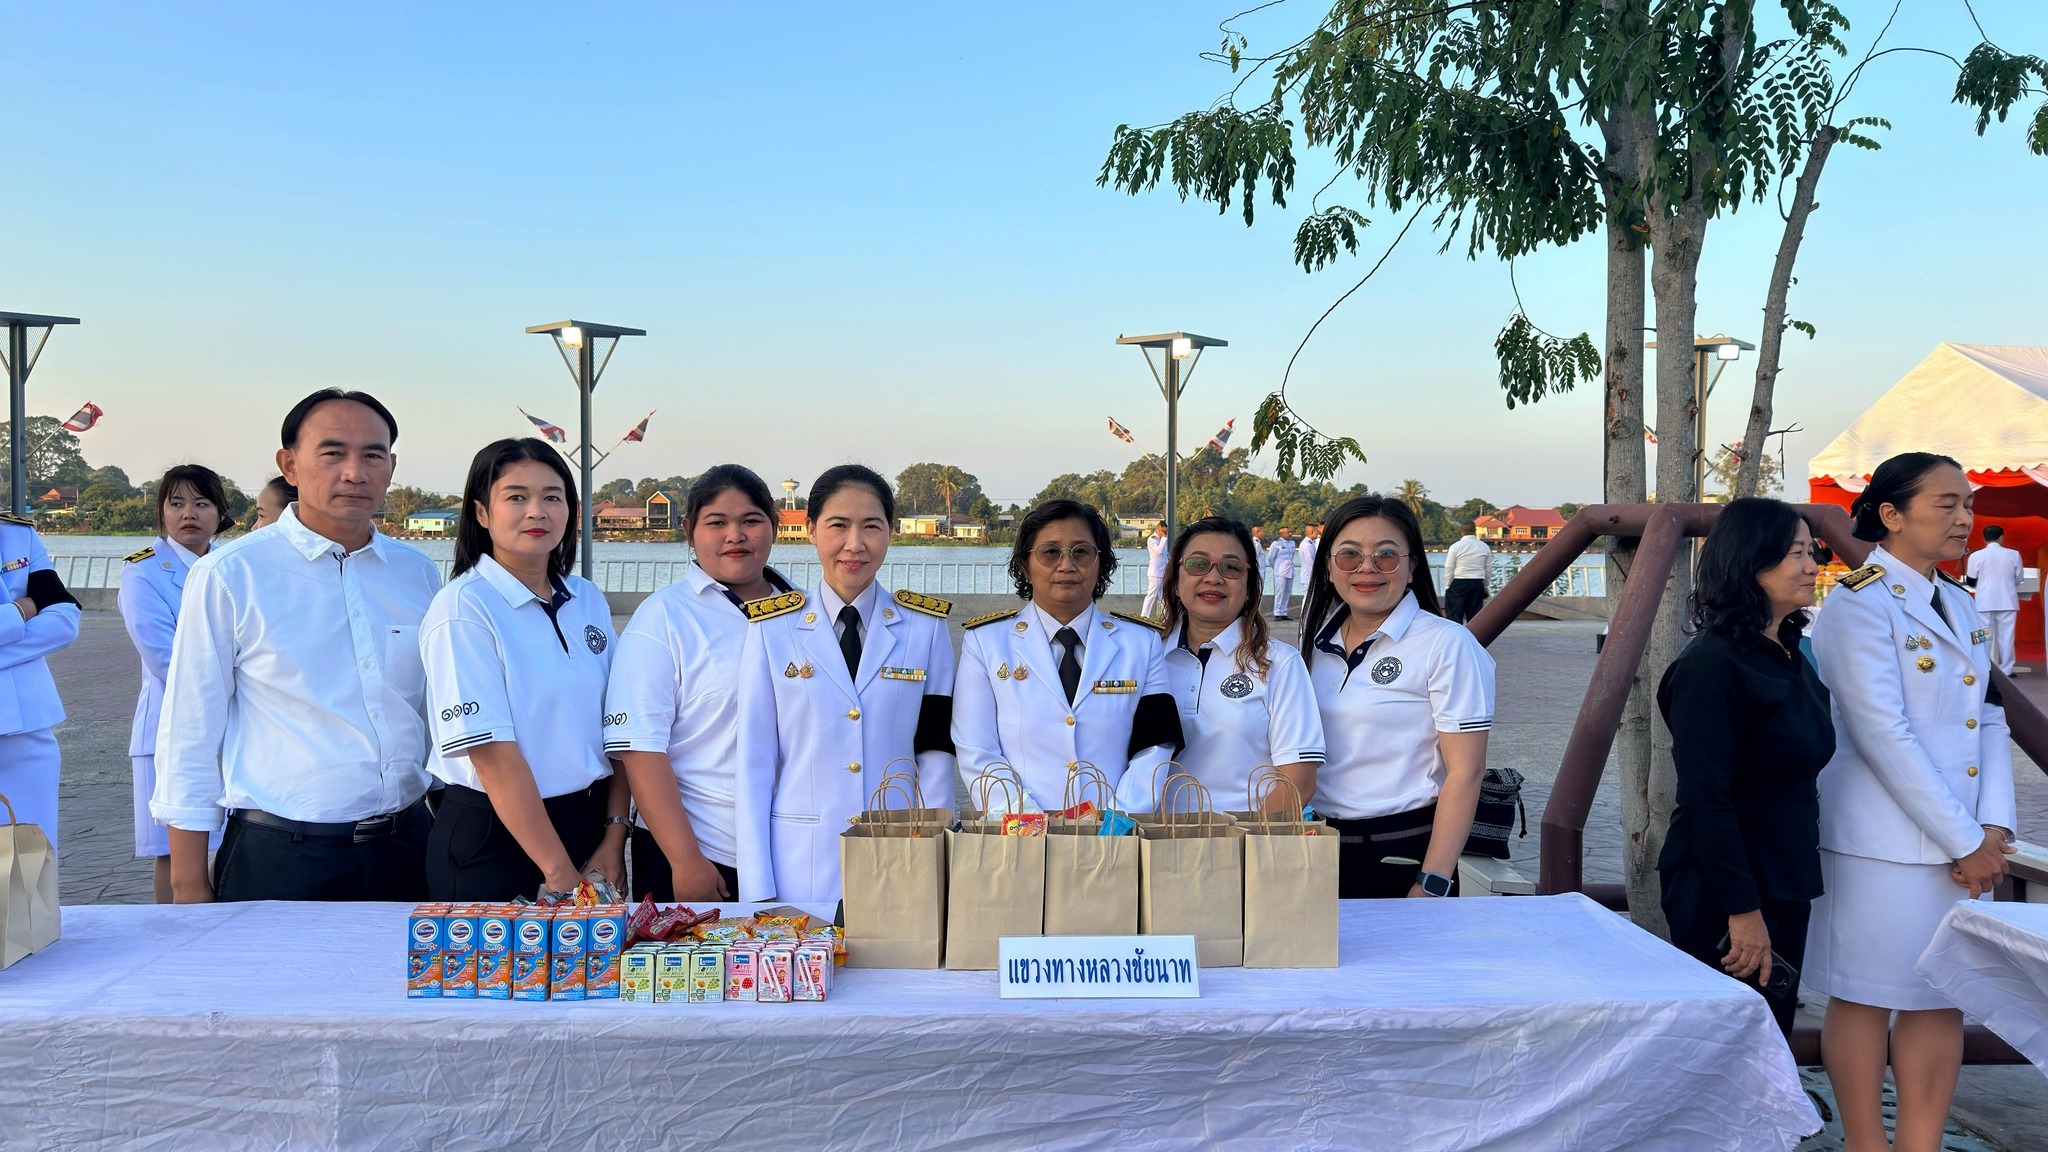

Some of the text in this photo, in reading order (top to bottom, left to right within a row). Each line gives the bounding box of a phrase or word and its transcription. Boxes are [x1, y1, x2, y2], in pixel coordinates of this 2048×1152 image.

[1009, 948, 1191, 983] แขวงทางหลวงชัยนาท
